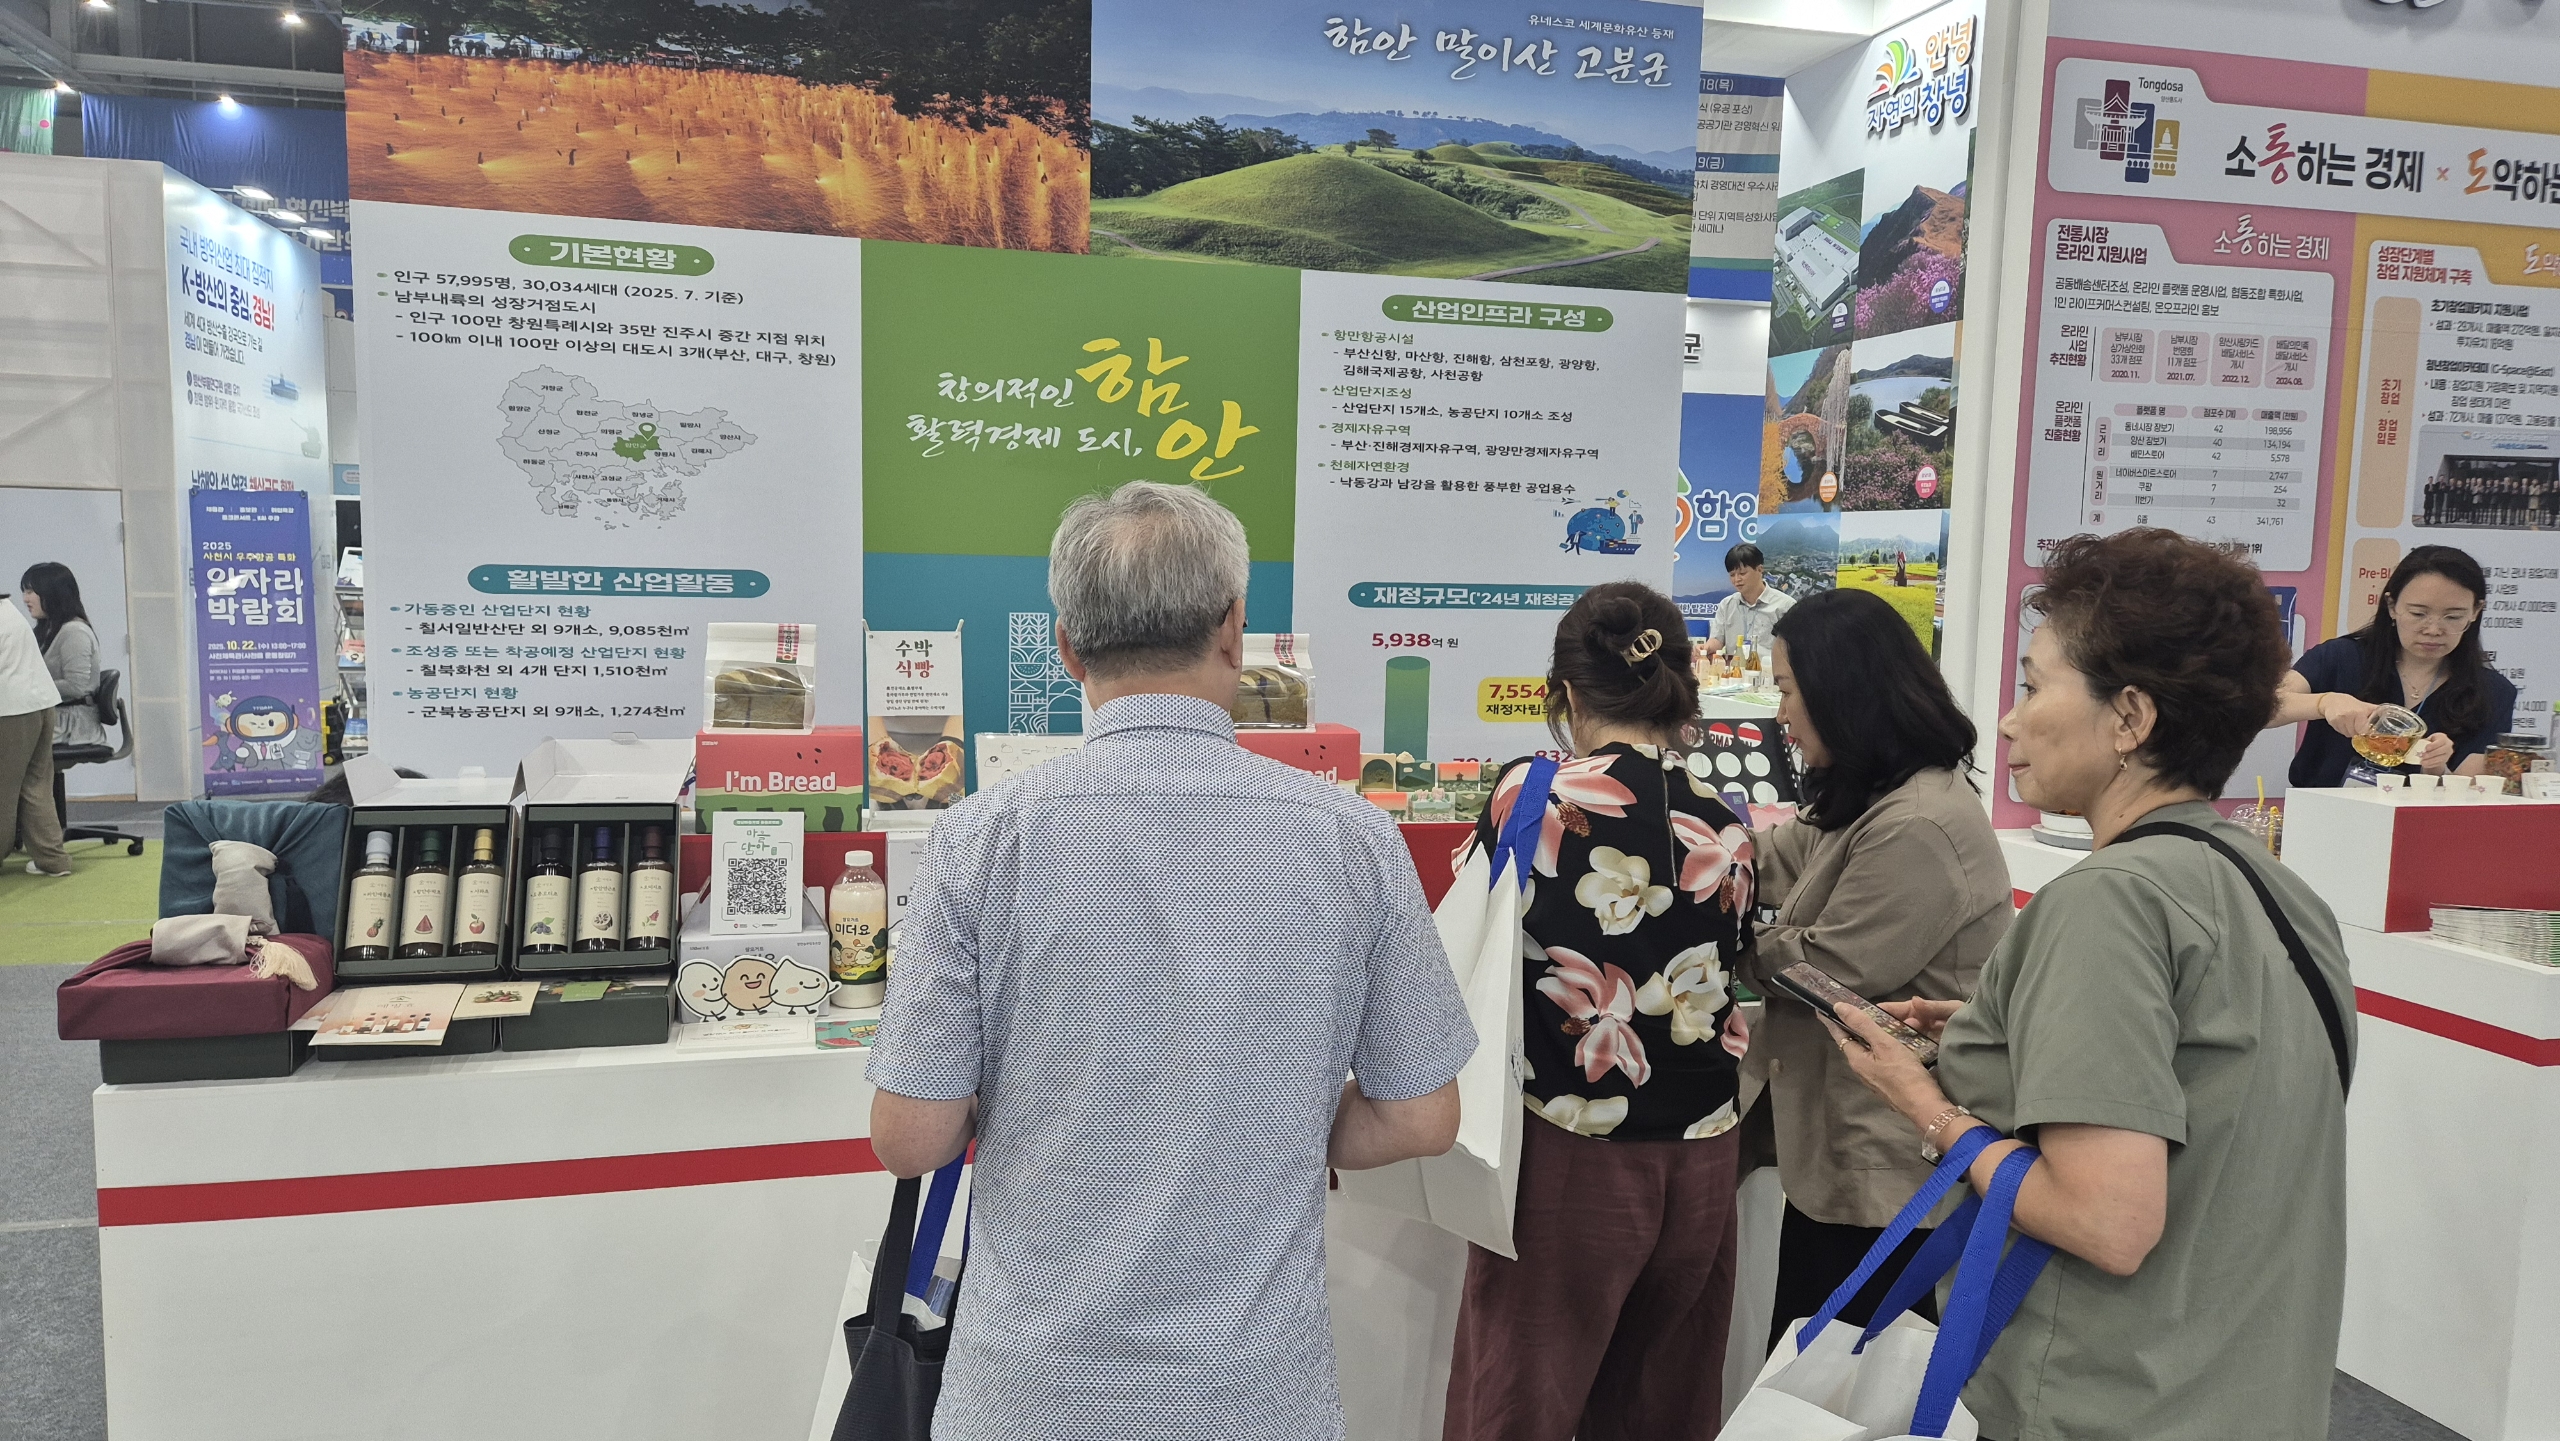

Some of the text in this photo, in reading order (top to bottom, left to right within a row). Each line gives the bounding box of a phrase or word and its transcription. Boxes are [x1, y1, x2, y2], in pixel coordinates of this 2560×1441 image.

[1528, 14, 1674, 39] 유네스코 세계문화유산 등재
[1323, 16, 1671, 88] 함안 말이산 고분군
[1925, 18, 1972, 69] 안녕
[2138, 77, 2183, 92] Tongdosa
[1868, 70, 1969, 132] 자연의 창녕
[2225, 122, 2423, 193] 소통하는 경제
[2057, 224, 2109, 243] 전통시장
[2214, 213, 2329, 261] 소통하는 경제
[549, 241, 677, 270] 기본현황
[2056, 244, 2147, 265] 온라인 지원사업
[2377, 264, 2399, 280] 창업
[2449, 269, 2472, 285] 구축
[393, 270, 744, 305] 인구 57,995명, 30,034세대 (2025. 7. 기준)
[2056, 277, 2129, 293] 공동배송센터조성,
[2133, 281, 2160, 294] 온라인
[2162, 283, 2189, 296] 플랫폼
[182, 264, 227, 313] K-방산의
[253, 295, 274, 331] 경남!
[394, 290, 597, 314] 남부내륙의 성장거점도시
[2054, 297, 2067, 309] 1인
[2155, 301, 2199, 316] 온오프라인
[2202, 304, 2219, 316] 홍보
[1412, 300, 1586, 327] 산업인프라 구성
[410, 310, 825, 348] 인구 100만 창원특례시와 35만 진주시 중간 지점 위치
[1334, 329, 1414, 345] 항만항공시설
[2061, 325, 2089, 338] 온라인
[469, 332, 502, 347] 이내
[508, 335, 561, 351] 100만
[566, 338, 616, 354] 이상의
[622, 341, 673, 357] 대도시
[678, 345, 750, 362] 3개(부산,
[756, 348, 792, 364] 대구,
[798, 351, 837, 367] 창원)
[2069, 340, 2087, 352] 사업
[1344, 348, 1600, 371] 부산신항, 마산항, 진해항, 삼천포항, 광양항,
[2050, 353, 2086, 366] 추진현황
[1344, 364, 1483, 382] 김해국제공항, 사천공항
[937, 372, 1074, 408] 창의적인
[1332, 385, 1412, 399] 산업단지조성
[2381, 379, 2401, 391] 초기
[2056, 401, 2083, 413] 온라인
[2381, 392, 2400, 405] 창업
[1342, 402, 1573, 422] 산업단지 15개소, 농공단지 10개소 조성
[906, 414, 1143, 458] 활력경제 도시,
[1332, 422, 1411, 436] 경제자유구역
[2045, 429, 2081, 442] 진출현황
[2265, 427, 2292, 435] 198,956
[1341, 440, 1599, 459] 부산·진해경제자유구역, 광양만경제자유구역
[1330, 459, 1410, 472] 천혜자연환경
[1340, 477, 1576, 494] 낙동강과 남강을 활용한 풍부한 공업용수
[203, 542, 232, 550] 2025
[207, 567, 303, 596] 일자리
[507, 569, 734, 594] 활발한 산업활동
[1524, 592, 1581, 606] 재정공
[208, 597, 303, 626] 박람회
[404, 602, 591, 619] 가동중인 산업단지 현황
[419, 621, 525, 637] 칠서일반산단
[532, 622, 547, 637] 외
[554, 623, 603, 638] 9개소,
[227, 641, 256, 650] 10. 22.
[895, 639, 933, 657] 수박
[1371, 632, 1458, 650] 5,938억 원
[406, 644, 686, 661] 조성중 또는 착공예정 산업단지 현황
[420, 663, 490, 678] 칠북화천
[497, 663, 513, 678] 외
[519, 664, 547, 678] 4개
[554, 664, 586, 678] 단지
[896, 660, 934, 678] 식빵
[407, 685, 518, 701] 농공단지 현황
[421, 704, 526, 719] 군북농공단지
[533, 704, 549, 719] 외
[555, 705, 604, 719] 9개소,
[725, 770, 836, 793] I'm Bread
[747, 829, 770, 843] 마을
[742, 842, 770, 855] 담아
[836, 924, 870, 936] 미더요
